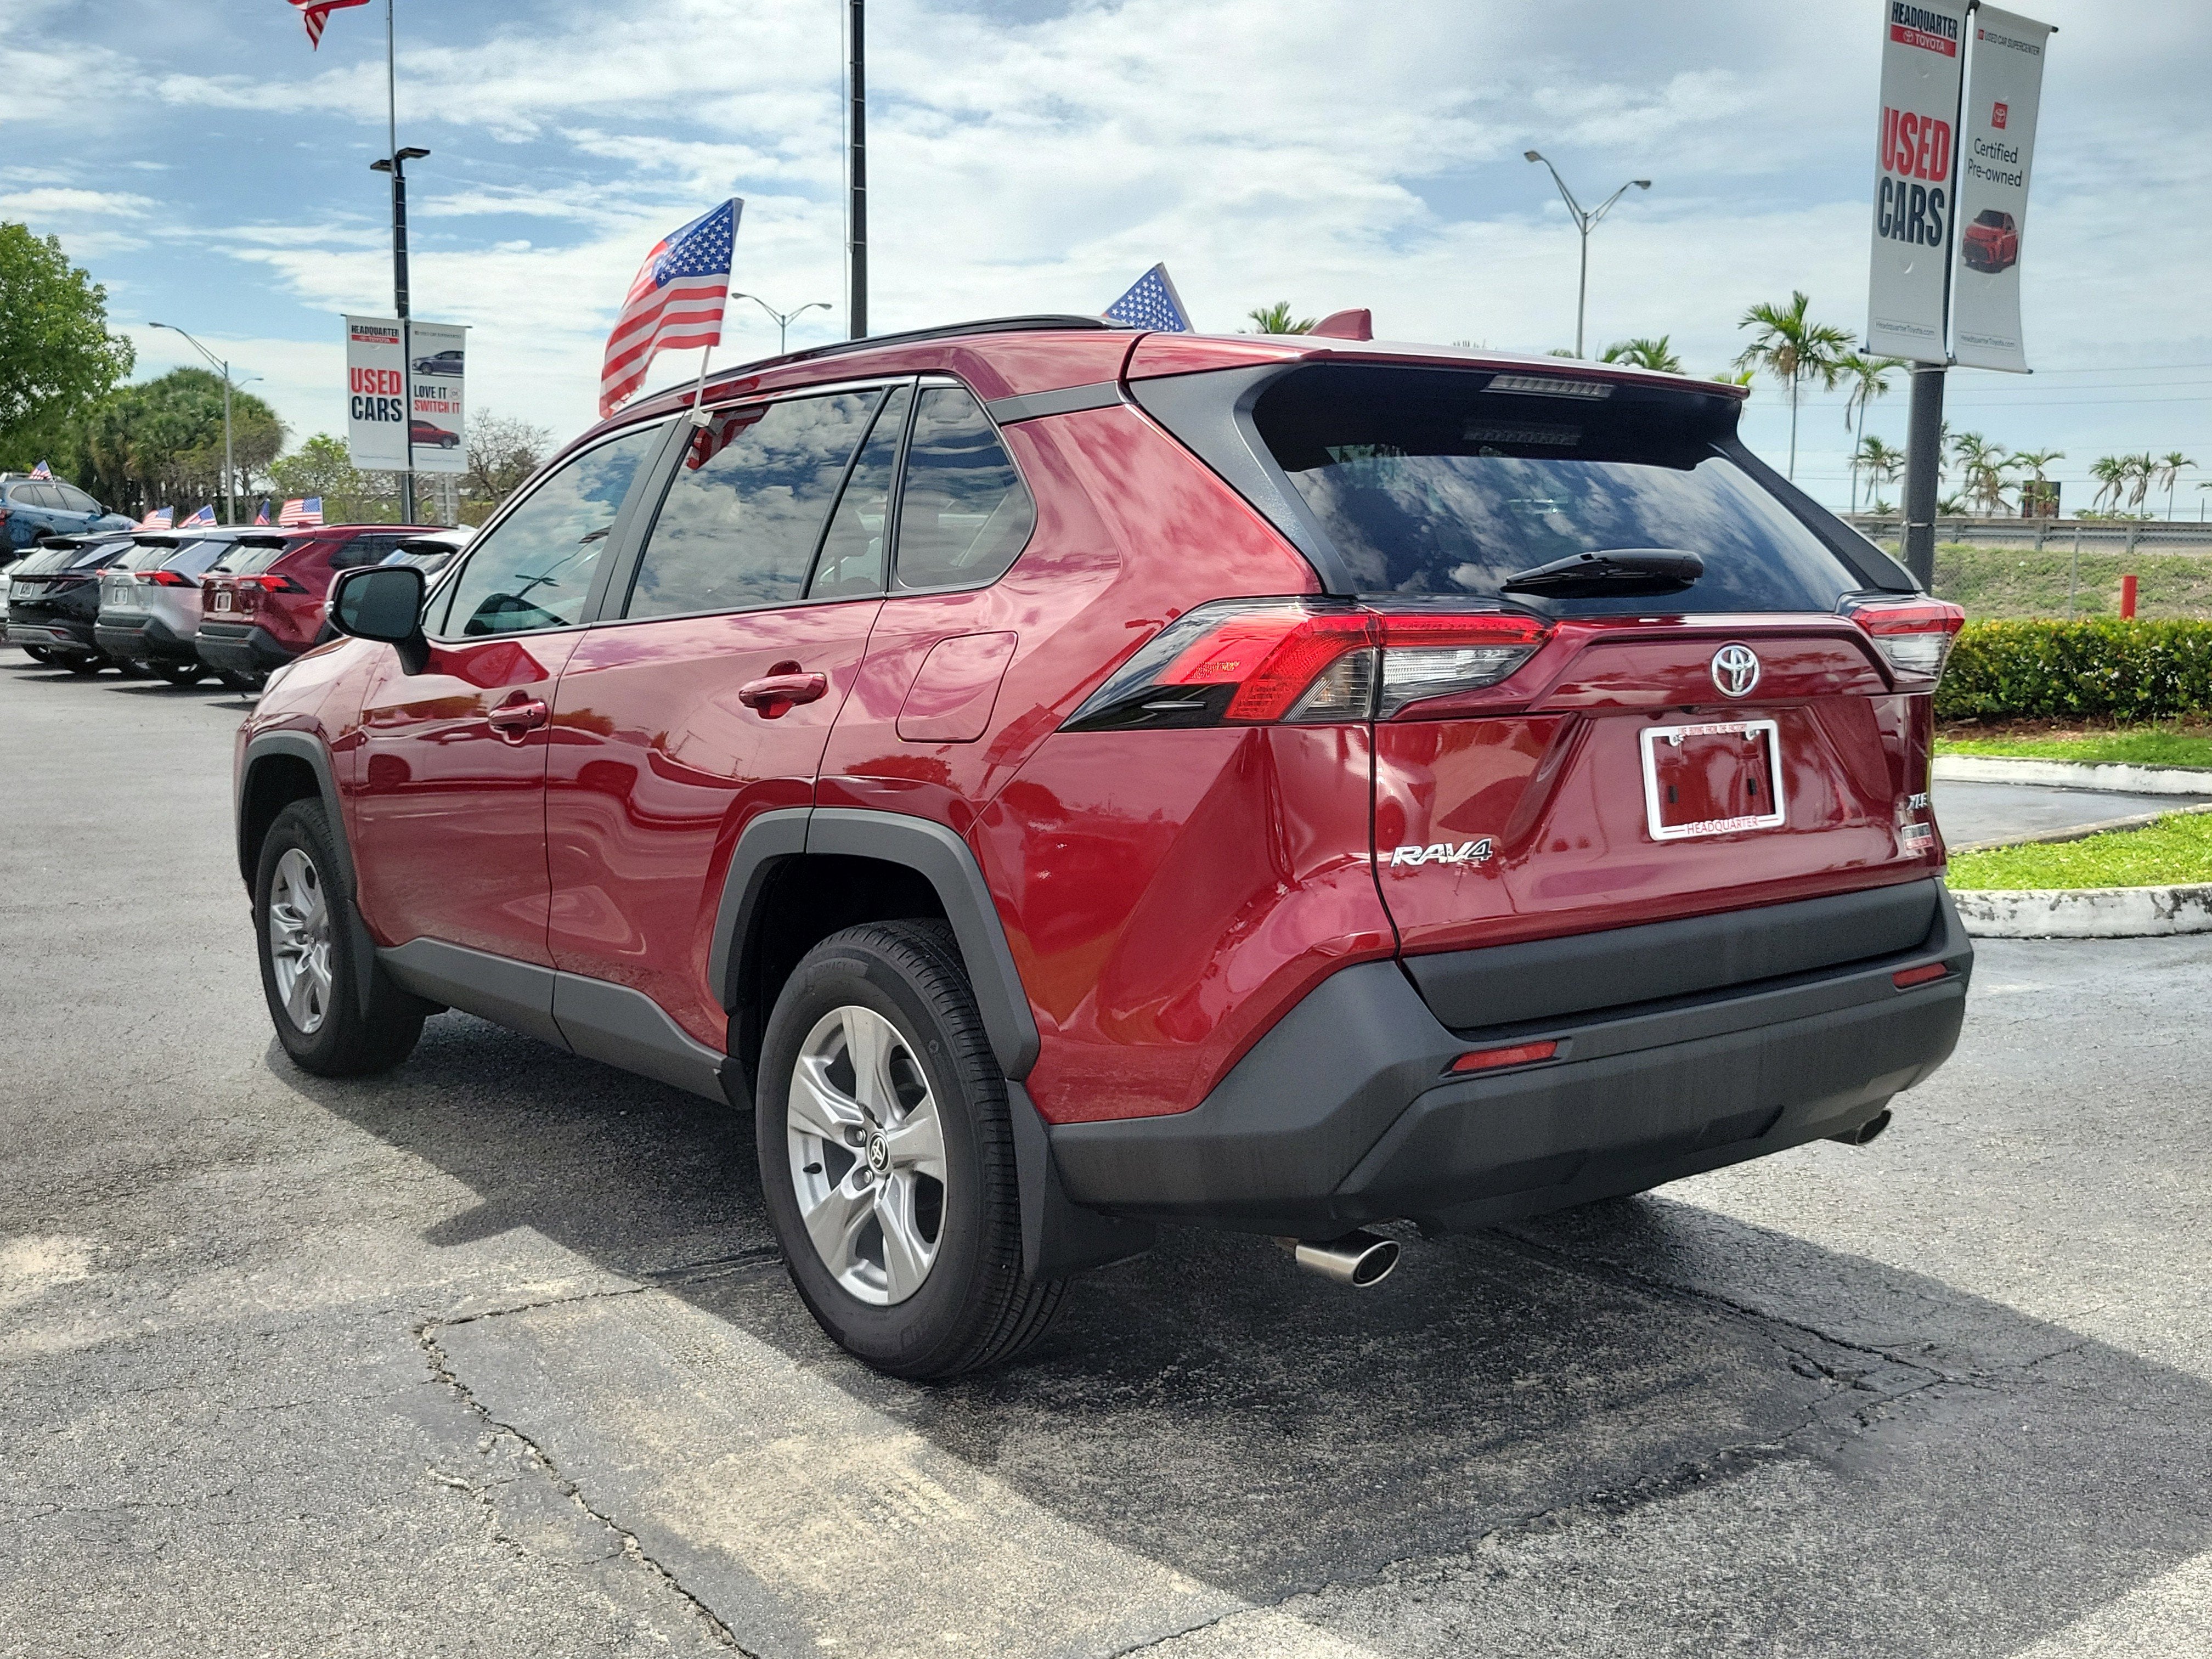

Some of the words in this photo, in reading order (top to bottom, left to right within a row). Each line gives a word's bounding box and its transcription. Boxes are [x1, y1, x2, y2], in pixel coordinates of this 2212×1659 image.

[1891, 1, 1957, 40] HEADQUARTER
[1915, 35, 1945, 53] TOYOTA
[1881, 106, 1950, 182] USED
[1974, 138, 2018, 163] Certified
[1967, 159, 2022, 187] Pre-owned
[1877, 177, 1944, 247] CARS
[352, 325, 399, 337] HEADQUARTER
[351, 367, 402, 396] USED
[414, 384, 436, 398] LOVE
[439, 387, 447, 399] IT
[352, 396, 403, 422] CARS
[414, 399, 449, 414] SWITCH
[453, 402, 460, 414] IT
[1687, 817, 1758, 834] HEADQUARTER
[1390, 838, 1493, 867] RAV4
